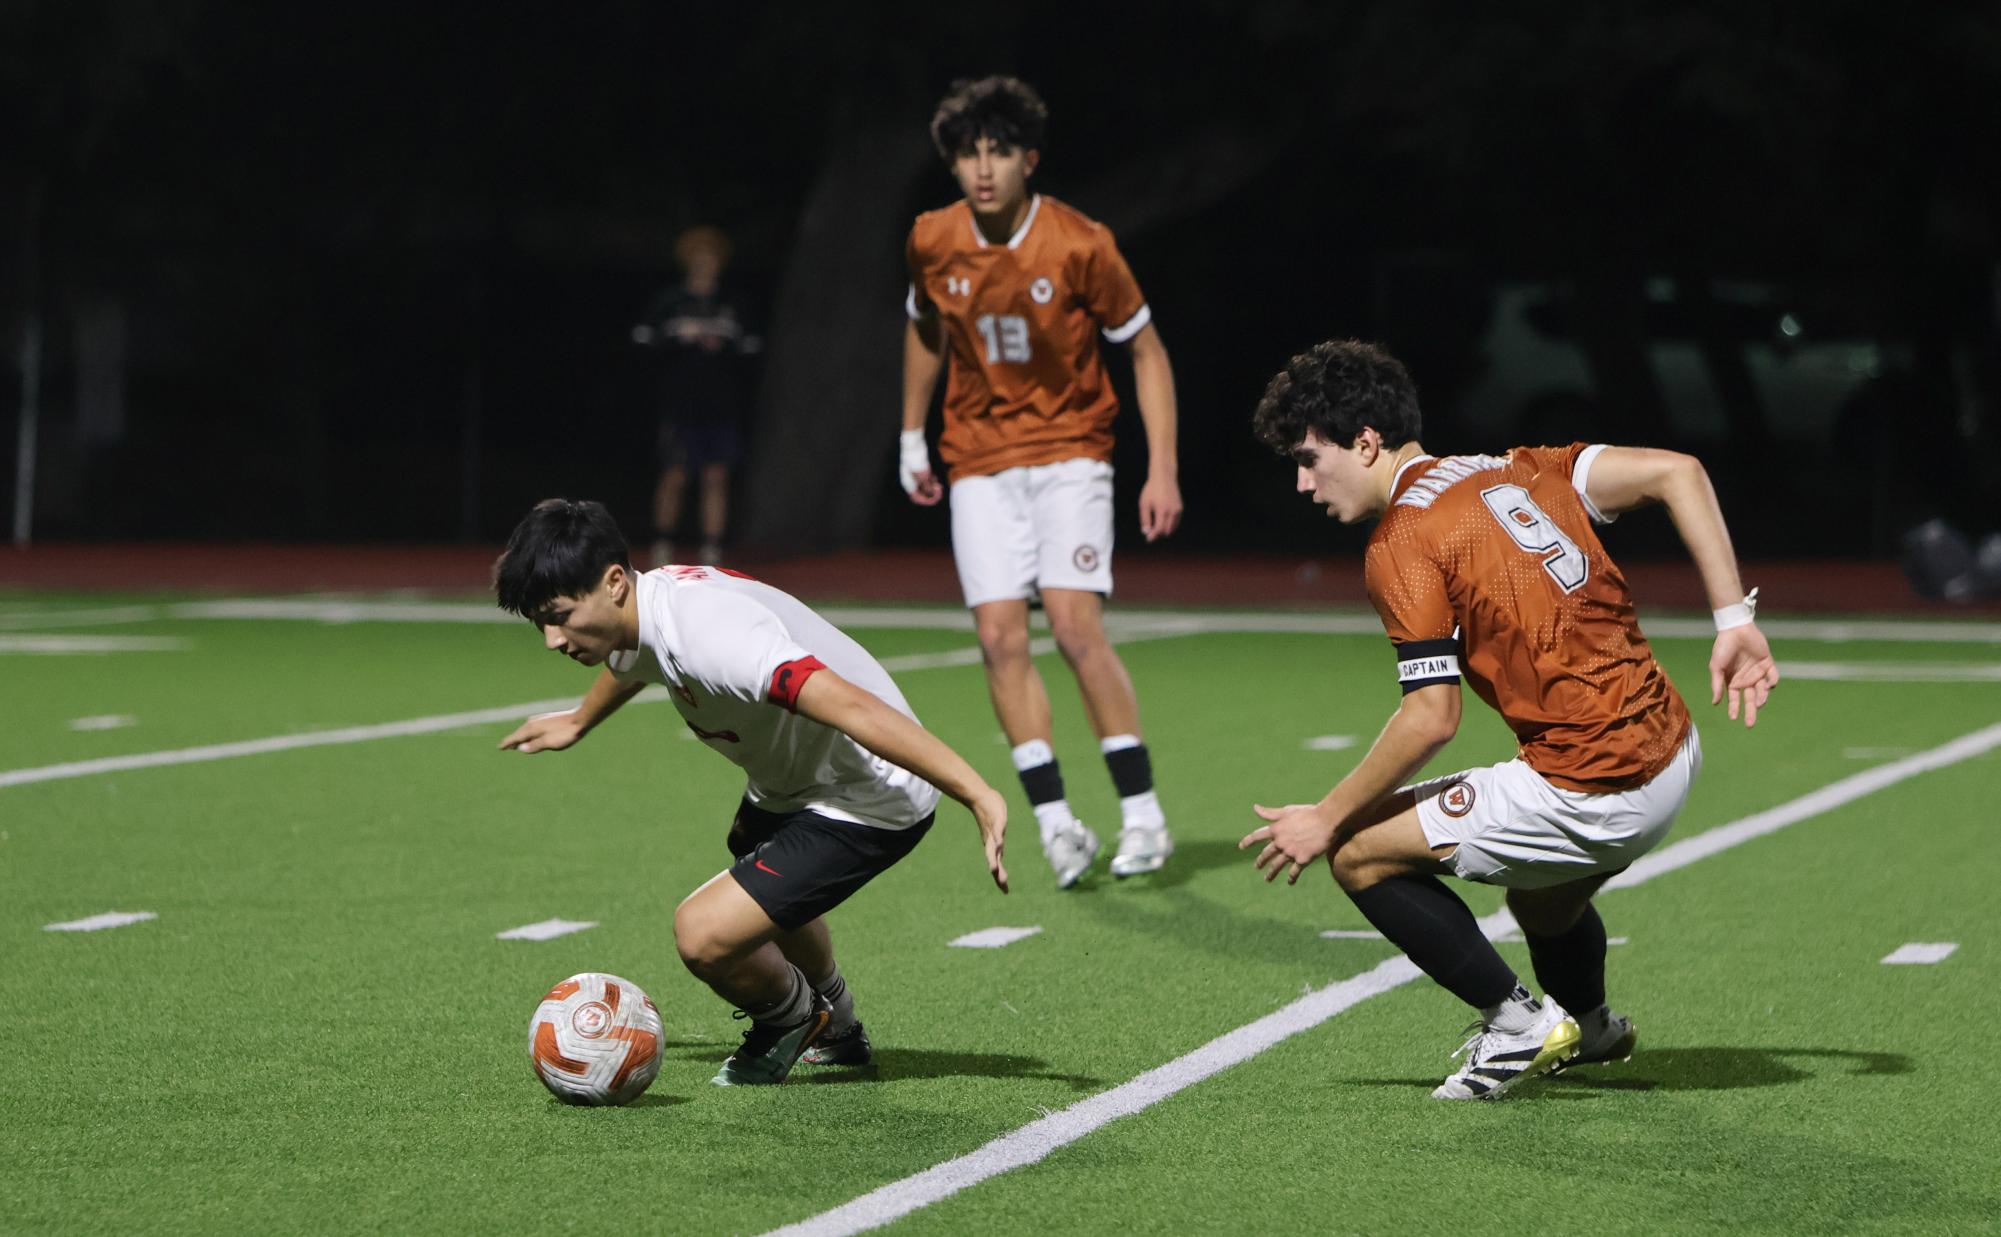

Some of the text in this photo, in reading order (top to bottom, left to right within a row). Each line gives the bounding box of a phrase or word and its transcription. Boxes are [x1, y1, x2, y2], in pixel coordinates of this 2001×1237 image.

[976, 314, 1031, 364] 13
[1480, 483, 1588, 594] 9
[1403, 659, 1448, 677] CAPTAIN
